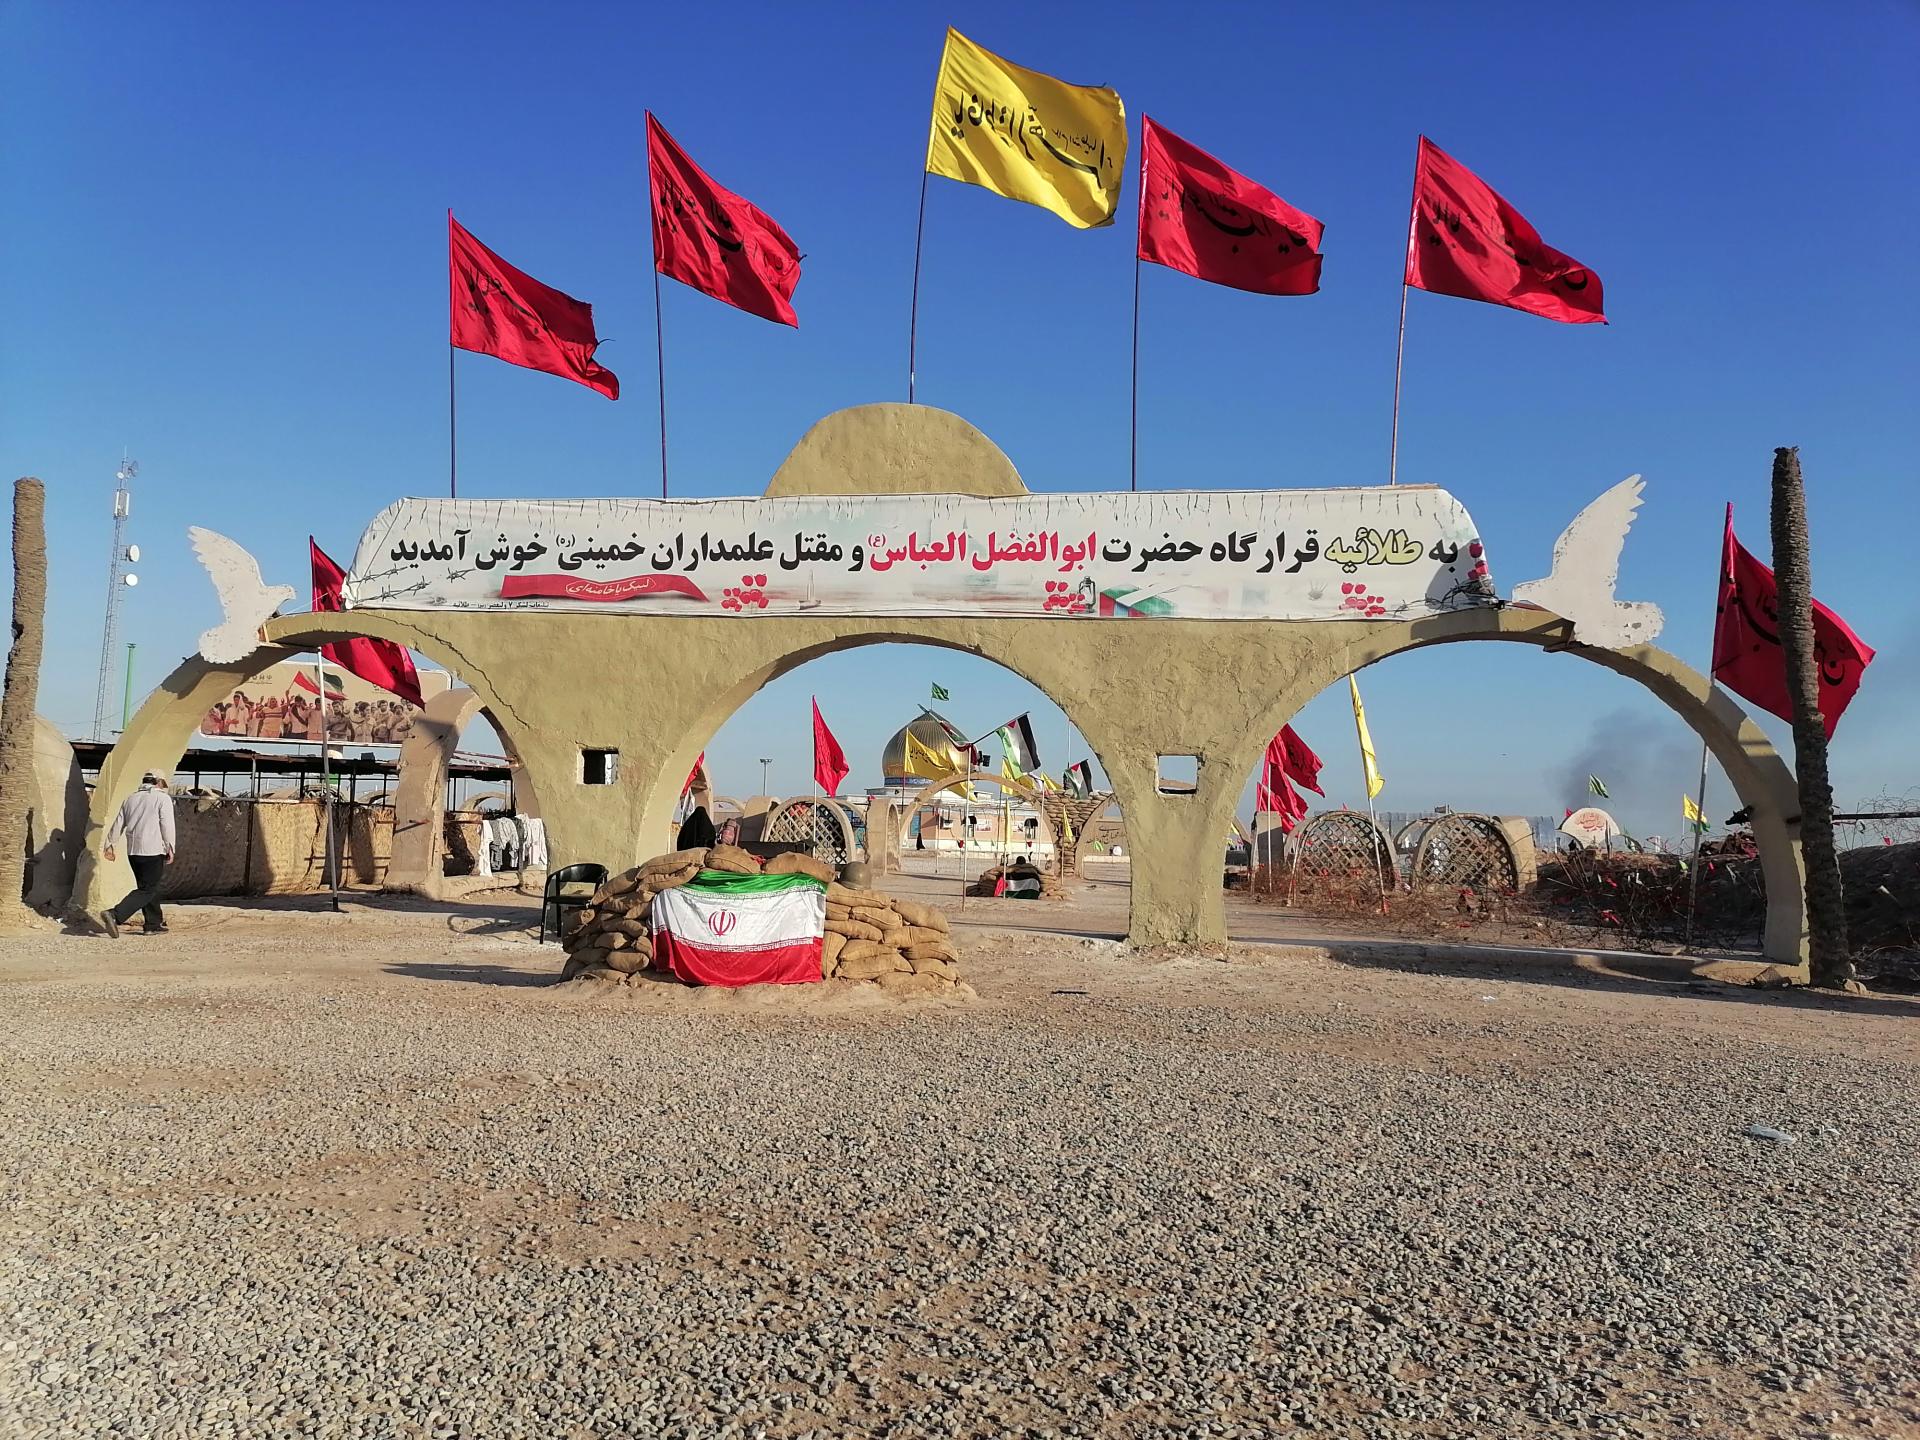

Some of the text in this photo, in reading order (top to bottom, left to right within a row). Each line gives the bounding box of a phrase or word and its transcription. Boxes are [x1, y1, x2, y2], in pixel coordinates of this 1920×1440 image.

[390, 529, 472, 569] آمدید
[475, 532, 548, 571] خوش
[650, 531, 774, 572] علمداران
[779, 532, 843, 571] مقتل
[847, 545, 864, 572] و
[971, 533, 1097, 572] ابوالفضل
[1101, 530, 1205, 574] حضرت
[1209, 529, 1320, 574] قرارگاه
[1323, 526, 1424, 574] طلائیه
[1428, 539, 1459, 574] به
